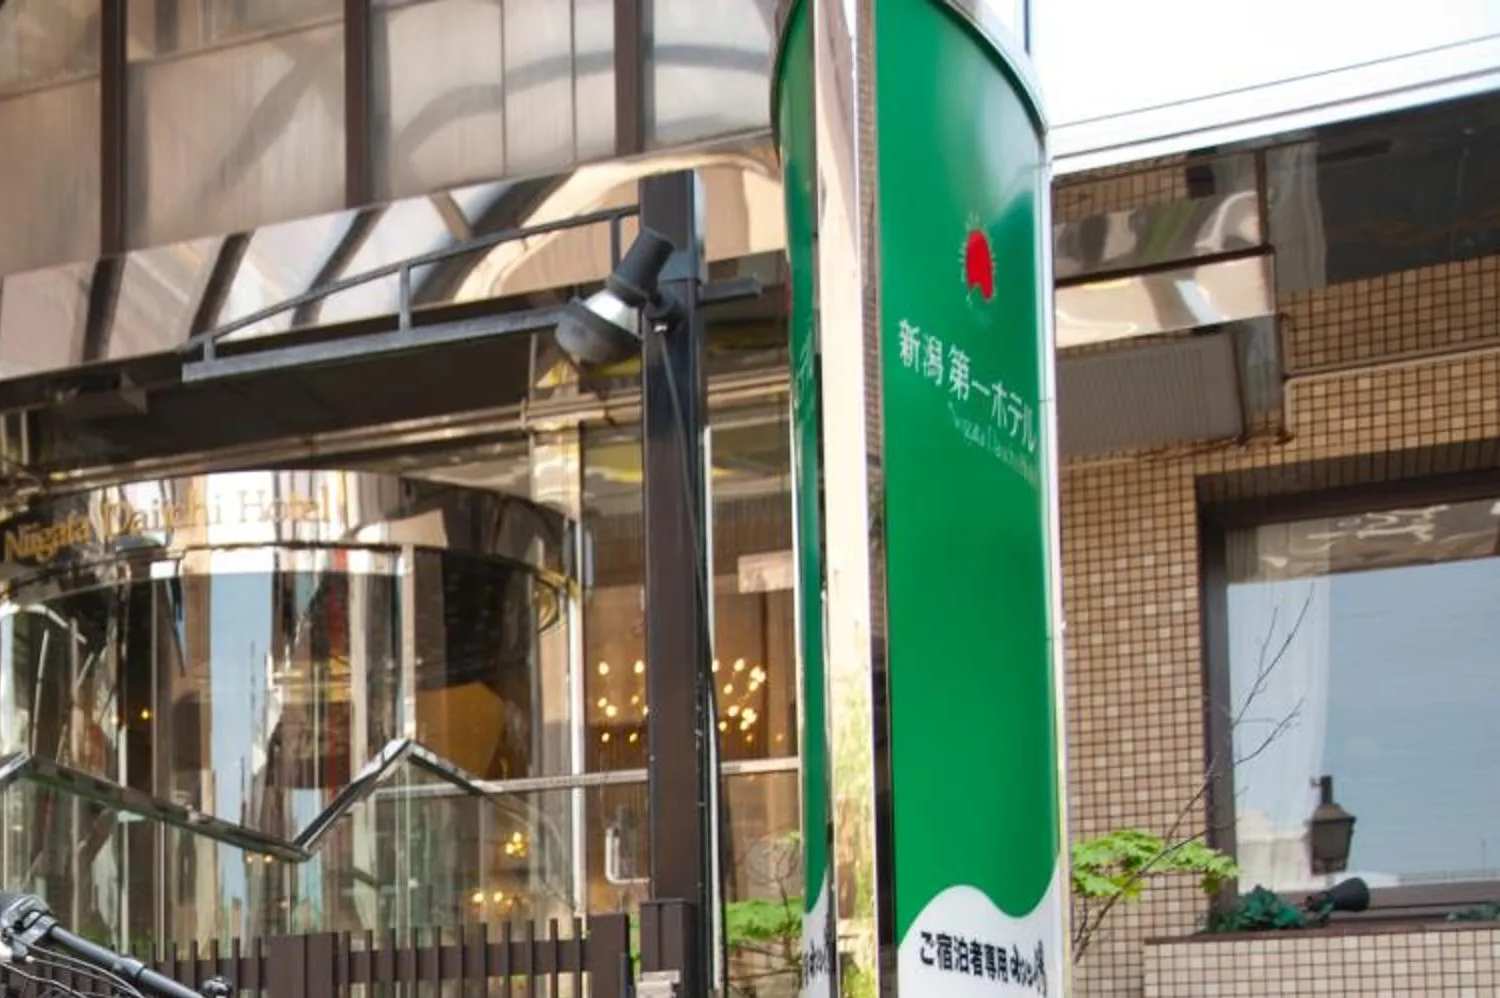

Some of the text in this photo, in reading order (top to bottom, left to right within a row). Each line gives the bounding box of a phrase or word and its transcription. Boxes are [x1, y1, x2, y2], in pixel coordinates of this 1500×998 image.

[898, 319, 1037, 453] 新潟第一ホテル
[238, 482, 331, 524] Hotel
